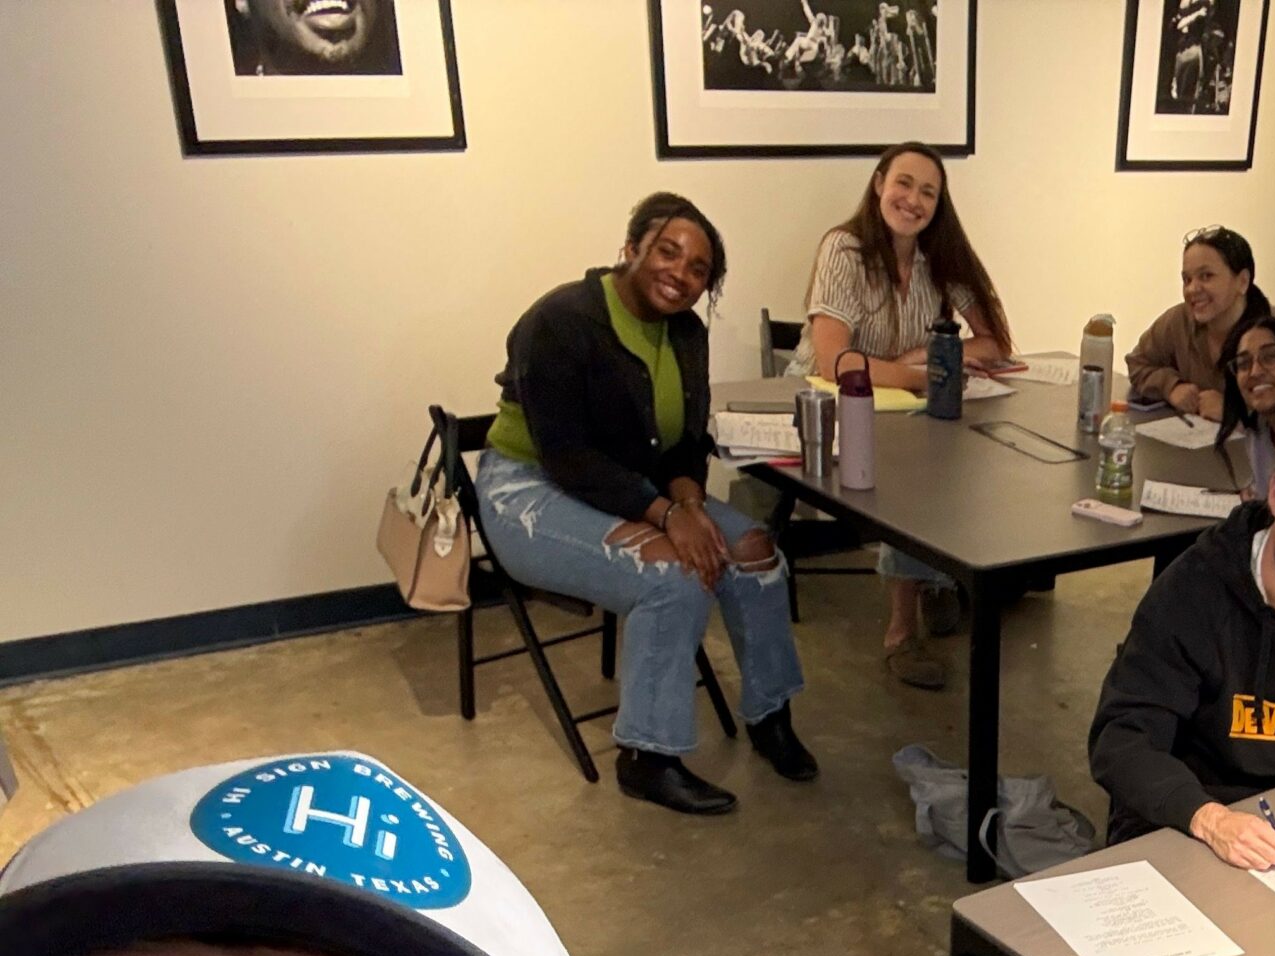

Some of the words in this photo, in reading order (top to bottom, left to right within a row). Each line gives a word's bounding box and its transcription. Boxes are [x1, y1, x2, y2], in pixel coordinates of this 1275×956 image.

[221, 787, 251, 805] HI
[255, 759, 332, 783] SIGN
[353, 764, 454, 863] BREWING
[283, 785, 399, 861] Hi
[222, 826, 327, 877] AUSTIN
[351, 873, 441, 894] TEXAS
